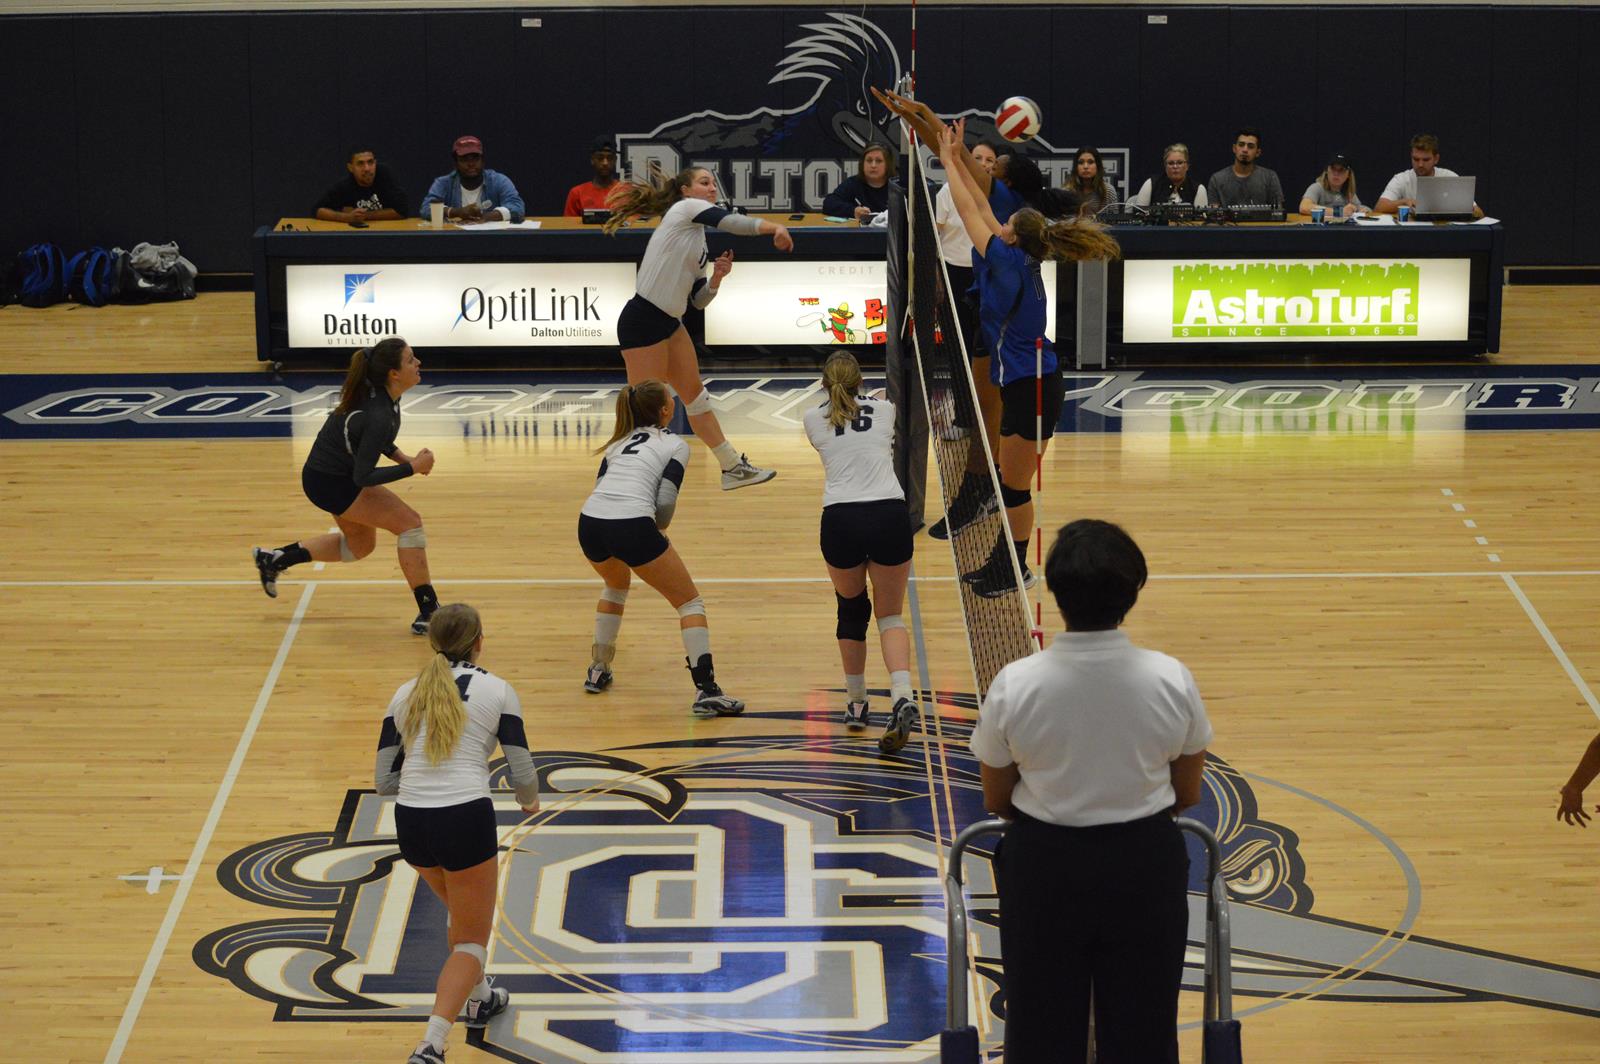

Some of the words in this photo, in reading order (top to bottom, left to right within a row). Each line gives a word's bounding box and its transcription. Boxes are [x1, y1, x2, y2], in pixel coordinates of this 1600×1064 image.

[627, 144, 859, 211] DLTO
[818, 265, 875, 276] CREDIT
[461, 287, 600, 330] OptiLink
[1182, 288, 1412, 325] AstroTurf
[324, 313, 397, 336] Dalton
[531, 327, 564, 337] Dalton
[565, 326, 602, 337] Utilities
[1181, 326, 1288, 337] SINCE
[1325, 325, 1405, 336] 1965
[1102, 382, 1600, 412] COUR
[621, 432, 651, 455] 2
